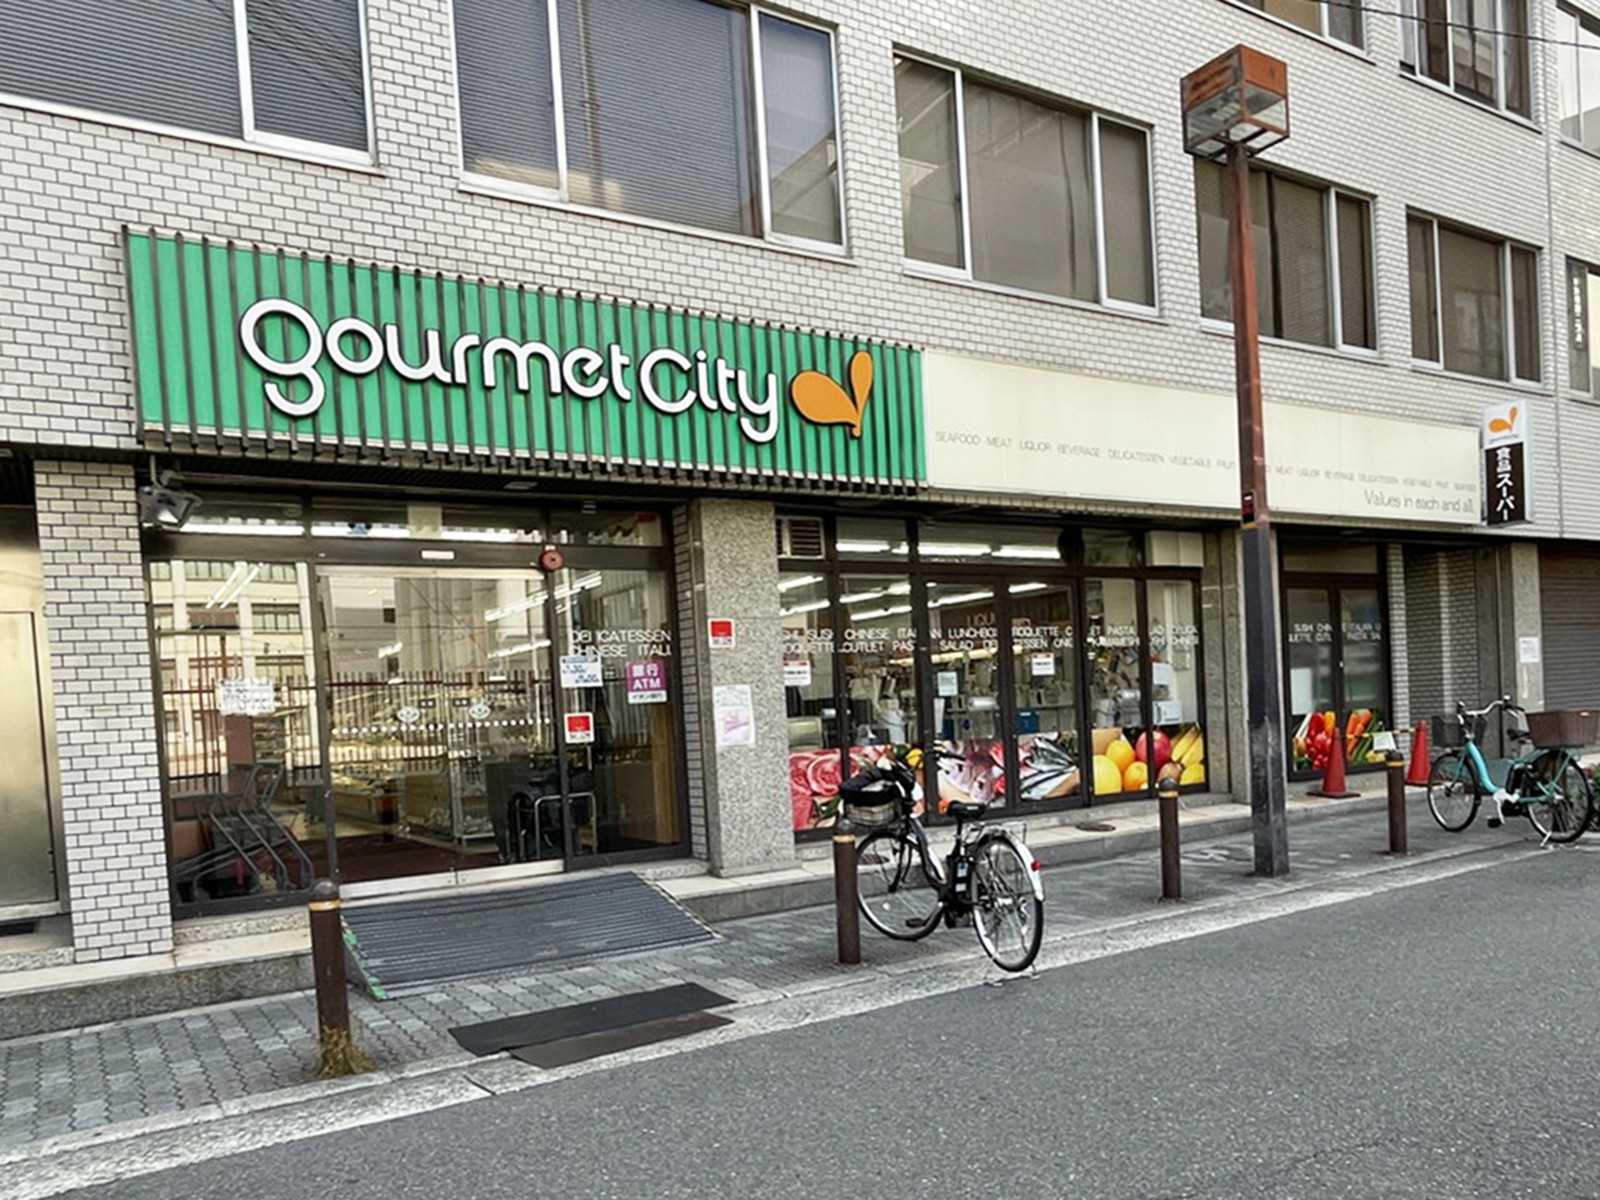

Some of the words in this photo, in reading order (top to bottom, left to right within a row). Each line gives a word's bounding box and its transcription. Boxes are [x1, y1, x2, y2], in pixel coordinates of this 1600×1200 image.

[934, 431, 981, 446] SEAFOOD
[986, 435, 1012, 448] MEAT
[1019, 440, 1052, 452] LIQUOR
[1057, 443, 1101, 459] BEVERAGE
[1107, 447, 1165, 464] DELICATESSEN
[1496, 446, 1516, 521] 食品スーパー
[1364, 489, 1402, 508] Values
[1405, 497, 1414, 508] in
[1416, 497, 1440, 511] each
[1442, 498, 1461, 513] and
[571, 629, 672, 643] DELICATESSEN
[633, 678, 661, 690] ATM
